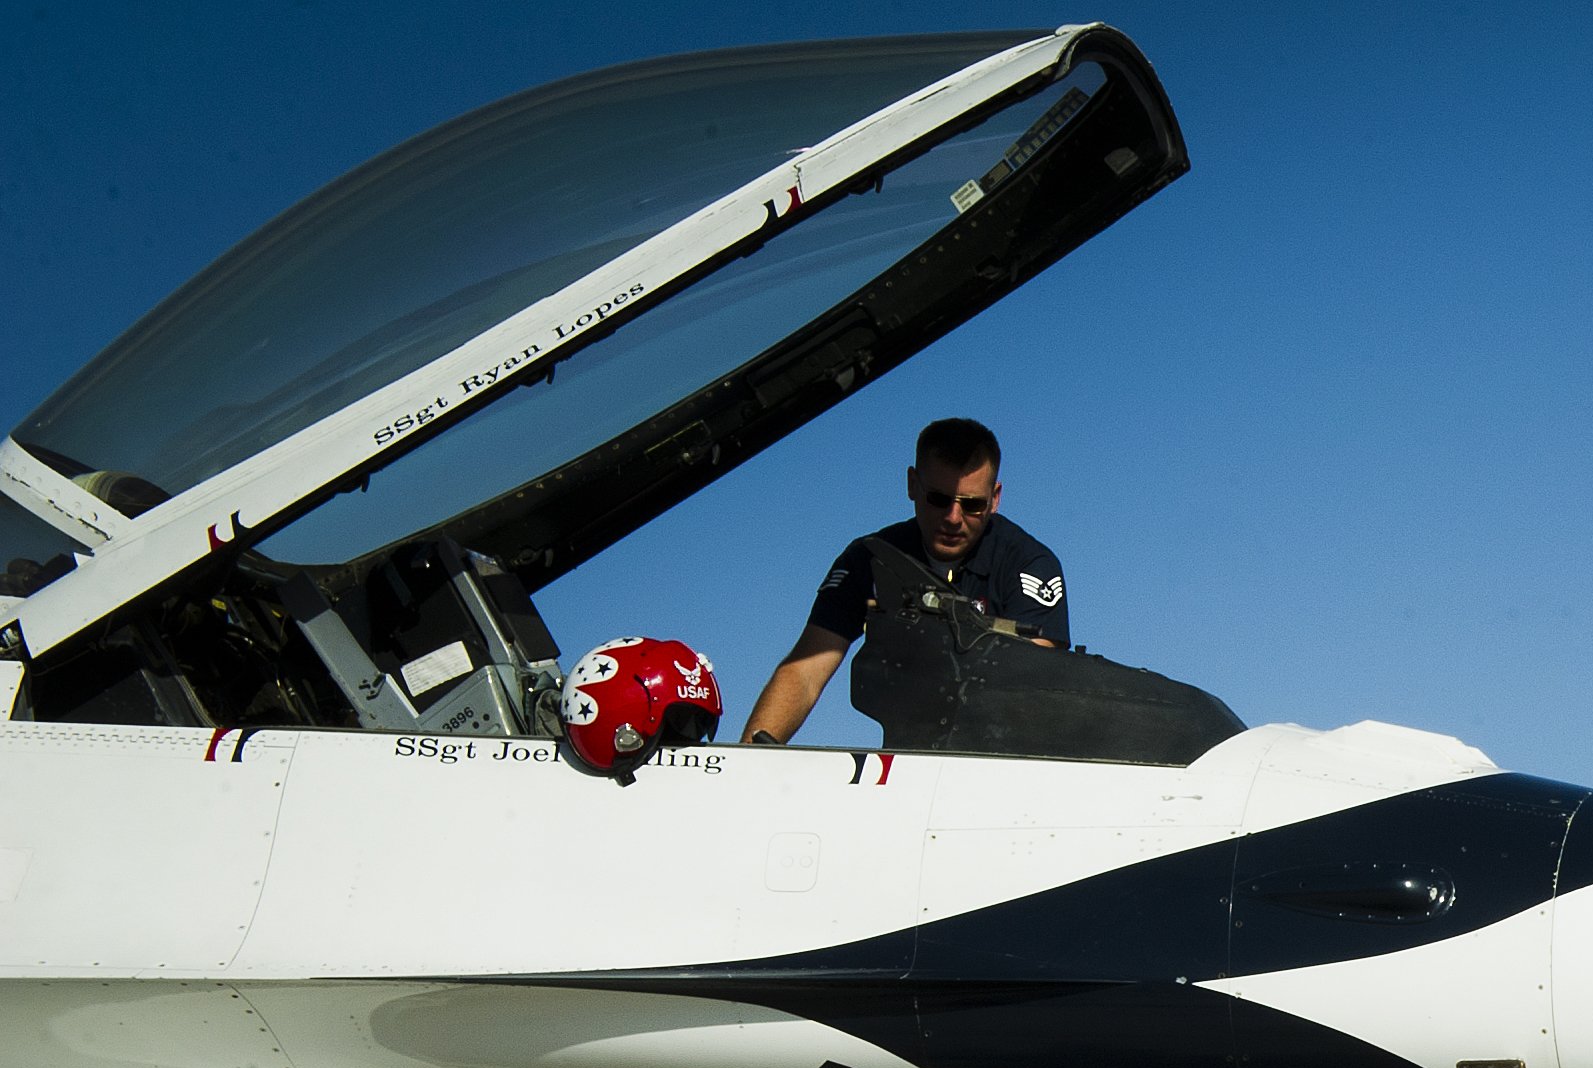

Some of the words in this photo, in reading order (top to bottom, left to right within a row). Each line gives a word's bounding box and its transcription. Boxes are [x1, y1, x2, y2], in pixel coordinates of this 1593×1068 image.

[373, 397, 449, 446] SSgt
[458, 342, 542, 396] Ryan
[552, 282, 645, 341] Lopes
[677, 685, 710, 699] USAF
[395, 737, 477, 765] SSgt
[492, 741, 562, 762] Joel
